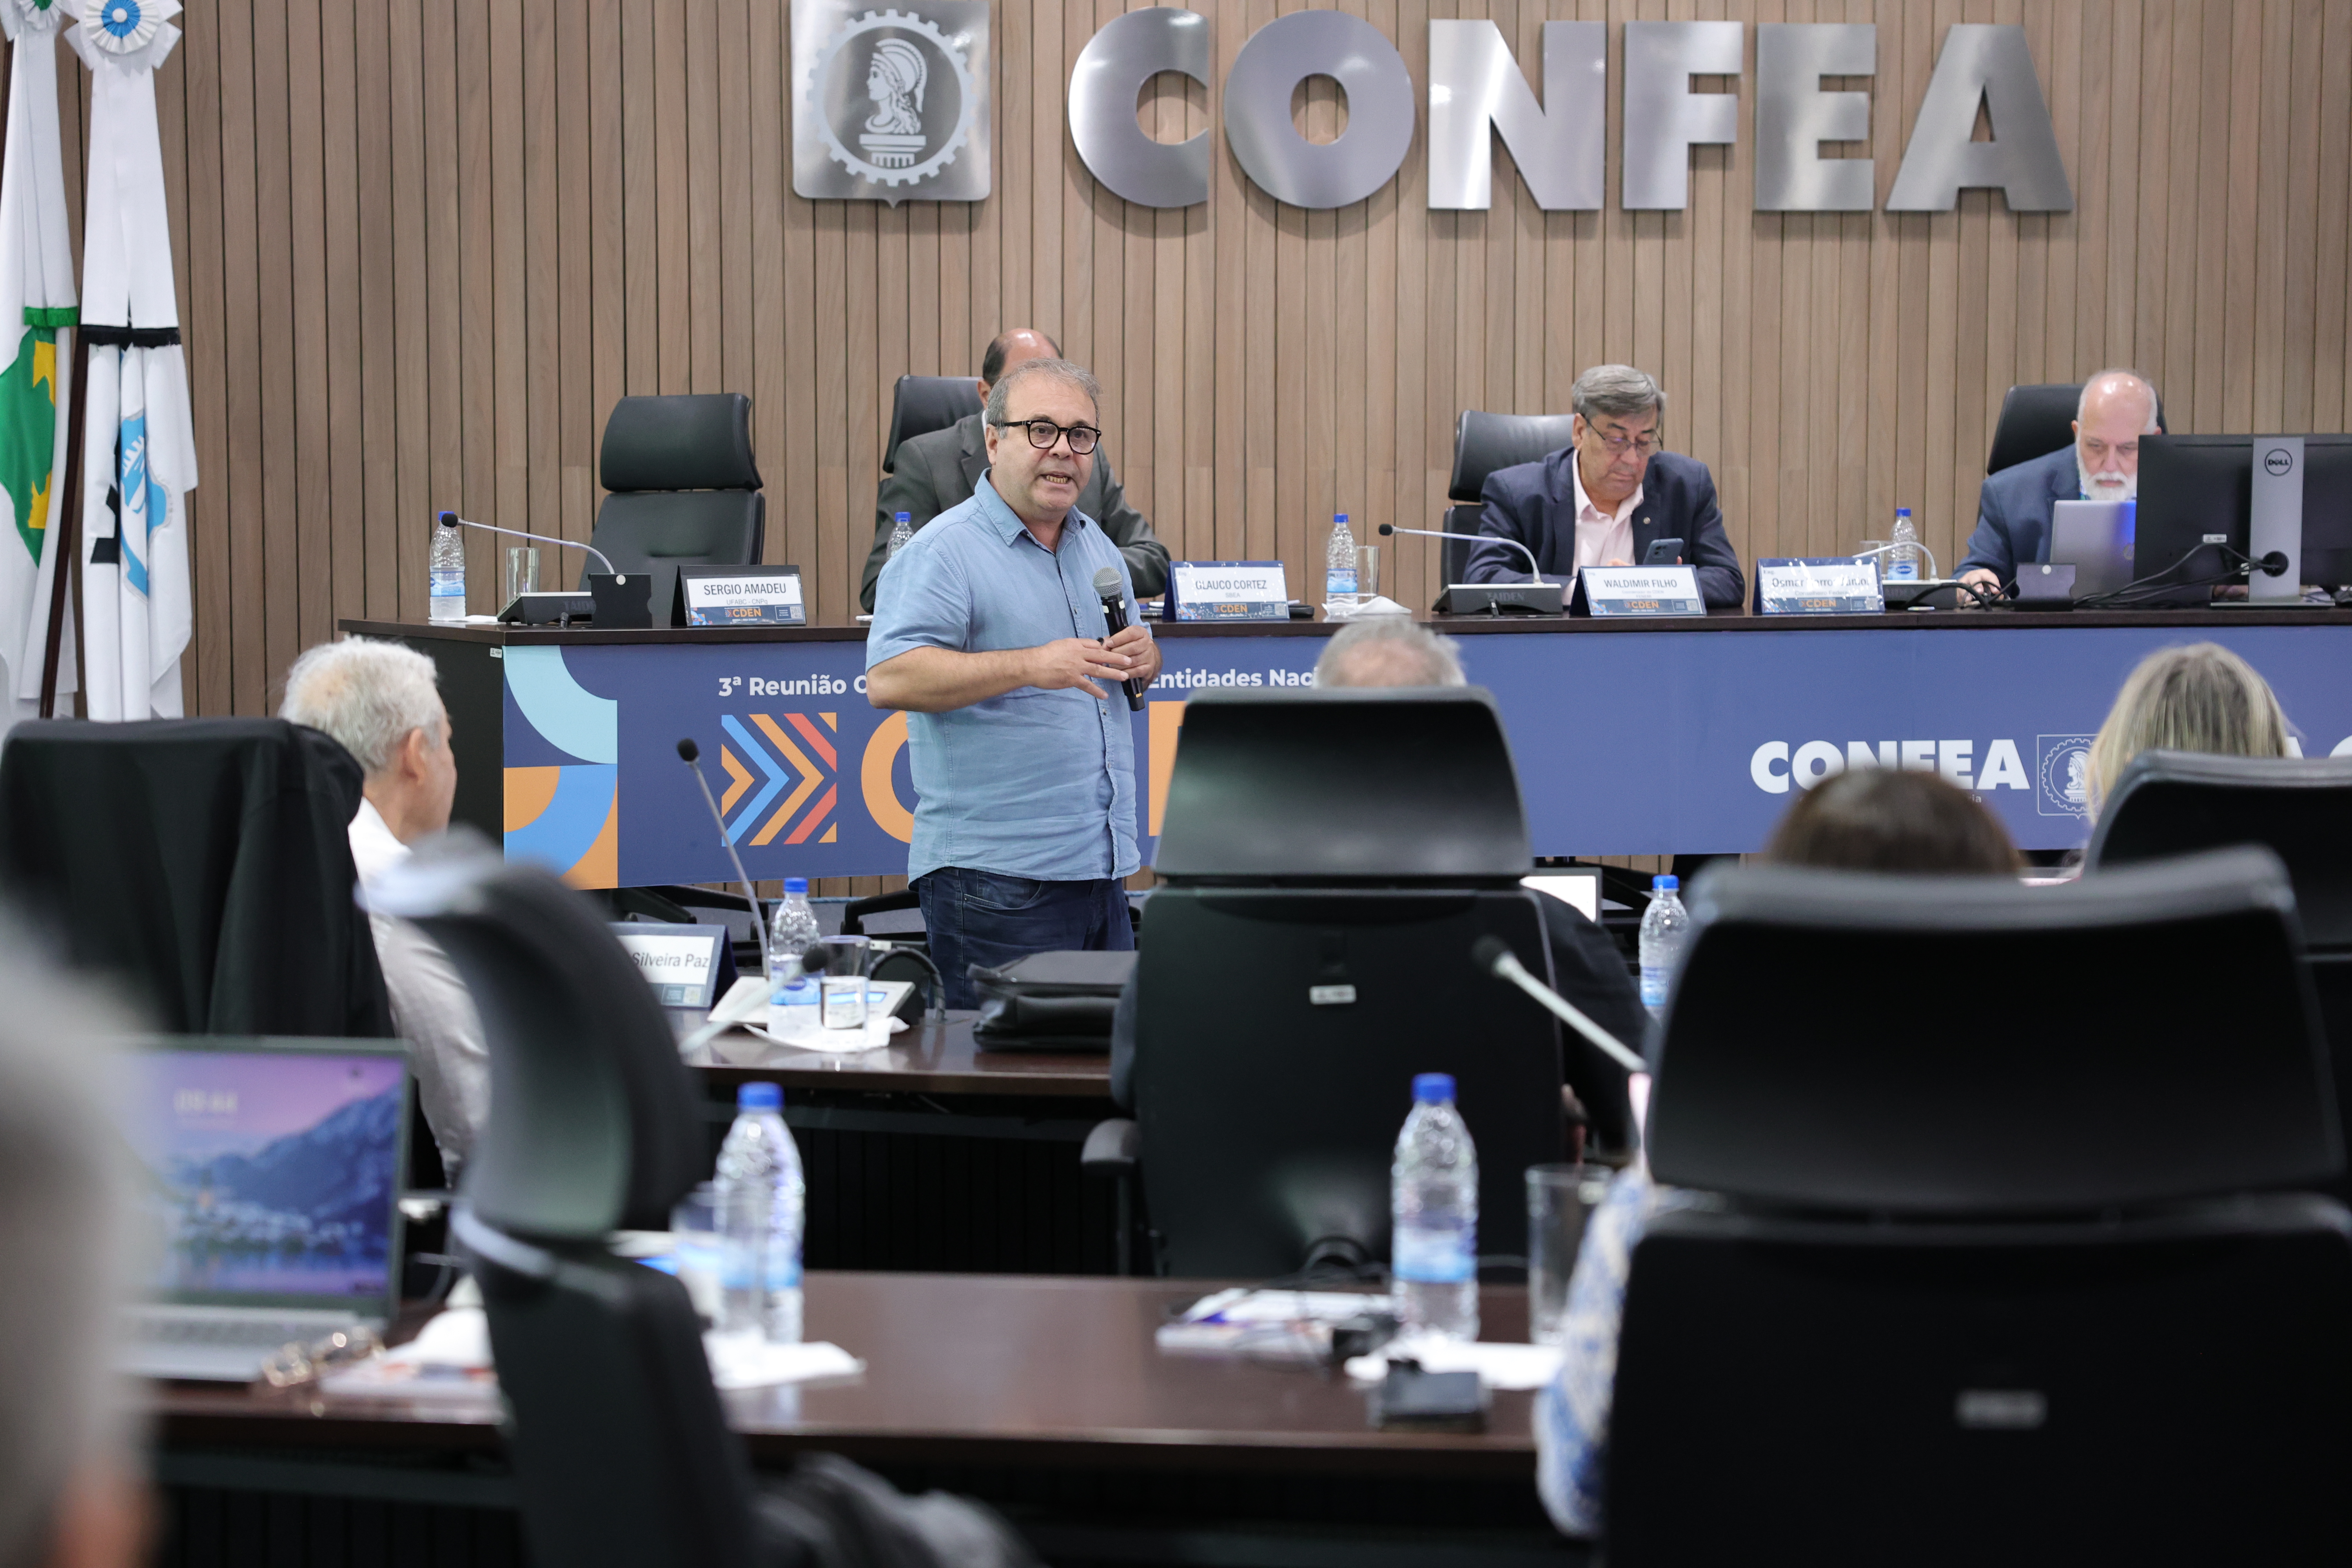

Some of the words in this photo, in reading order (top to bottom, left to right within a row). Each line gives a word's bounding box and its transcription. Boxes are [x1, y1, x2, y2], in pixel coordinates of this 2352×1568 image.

[1068, 6, 2076, 212] CONFEA
[1196, 580, 1231, 590] GLAUCO
[1234, 580, 1267, 589] CORTEZ
[1604, 579, 1650, 588] WALDIMIR
[1652, 579, 1677, 588] FILHO
[1772, 578, 1804, 587] Osmar
[704, 584, 742, 595] SERGIO
[745, 583, 786, 594] AMADEU
[733, 608, 762, 617] CDEN
[1220, 604, 1248, 613] CDEN
[750, 674, 847, 696] Reunião
[1750, 739, 2031, 794] CONFEA
[633, 952, 681, 967] Silveira
[685, 953, 709, 967] Paz
